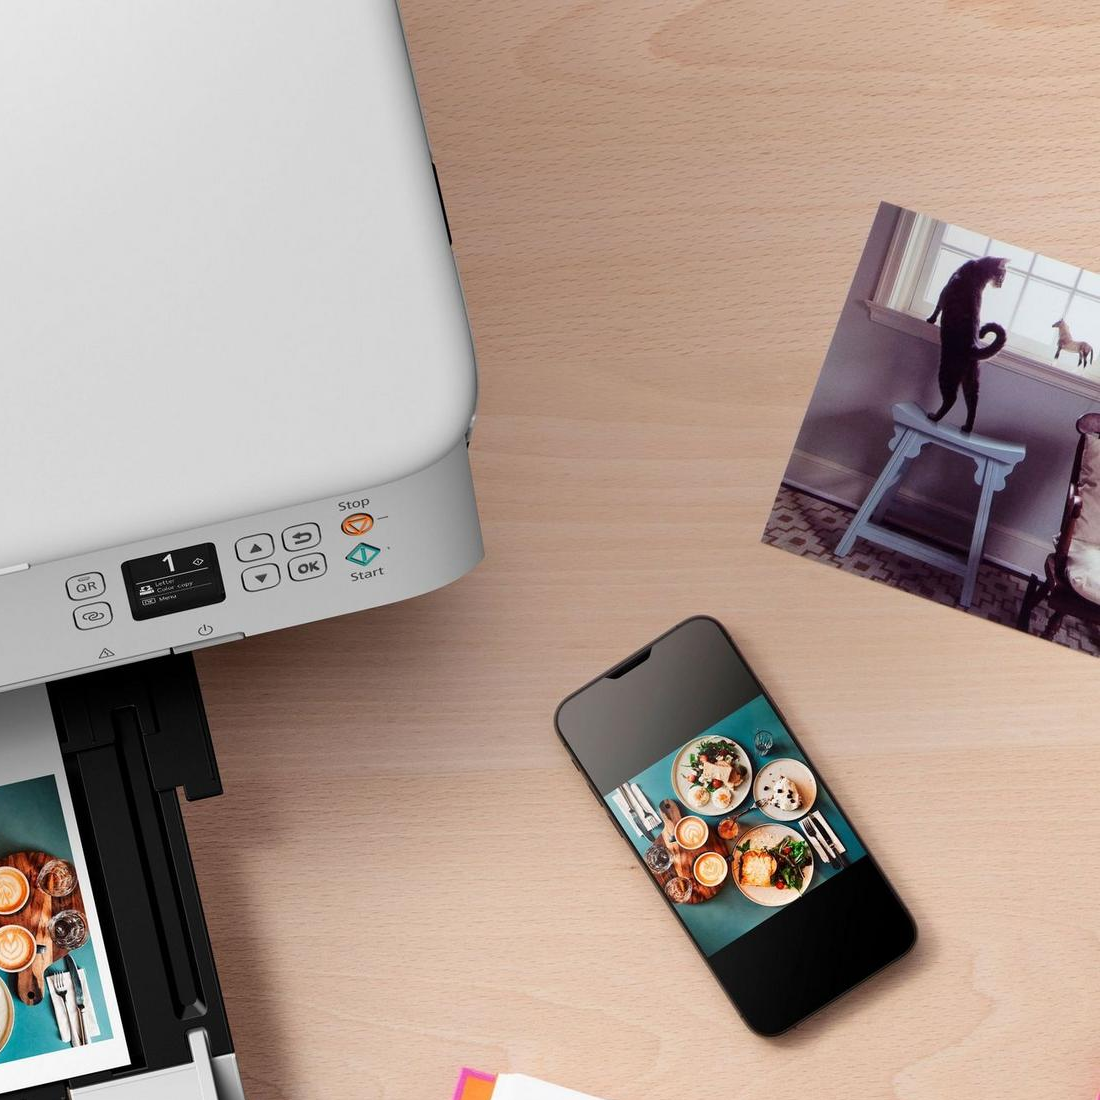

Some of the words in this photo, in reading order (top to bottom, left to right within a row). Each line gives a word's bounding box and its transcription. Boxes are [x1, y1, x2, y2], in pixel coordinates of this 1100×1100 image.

[338, 498, 370, 512] Stop
[162, 553, 175, 572] 1
[297, 560, 320, 575] OK
[350, 567, 384, 582] Start
[76, 581, 98, 593] QR
